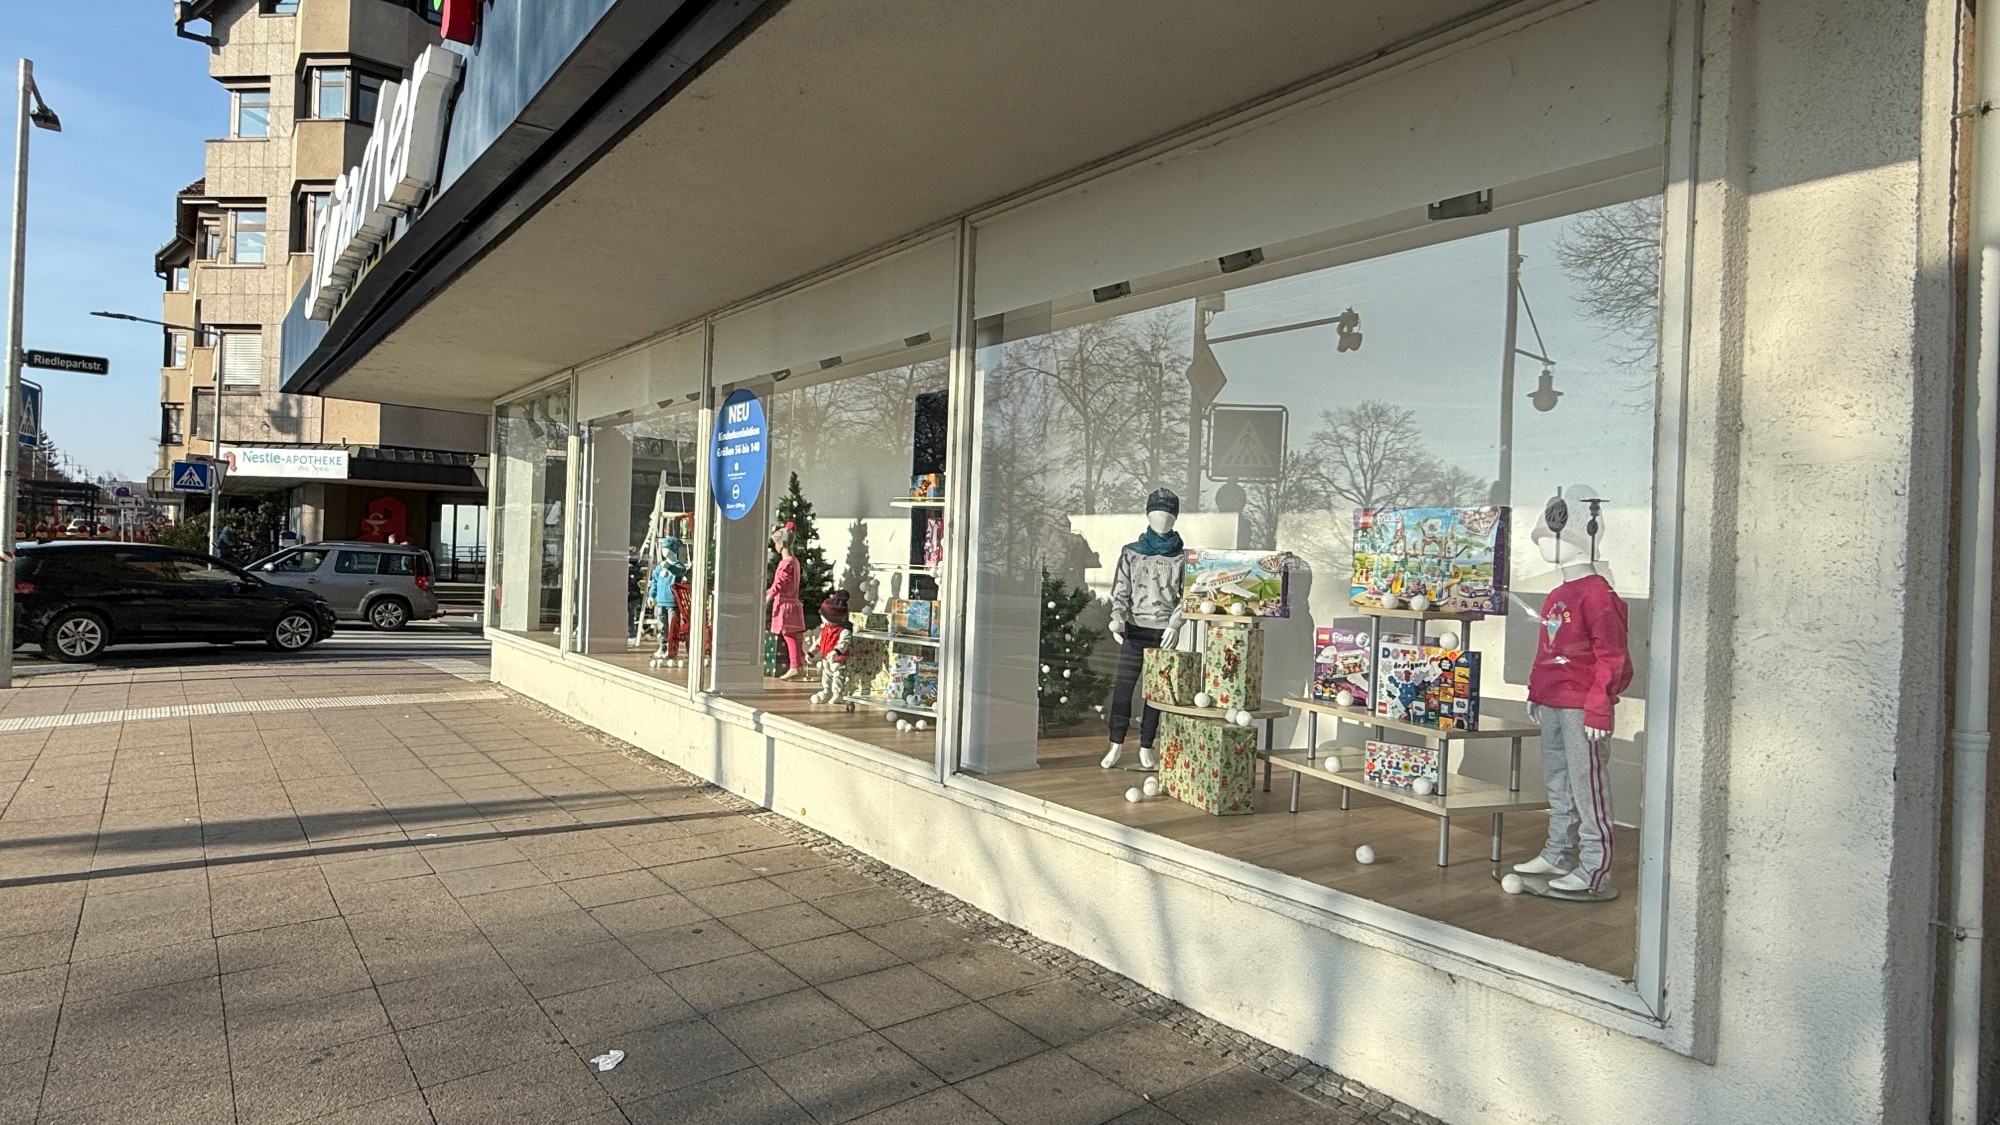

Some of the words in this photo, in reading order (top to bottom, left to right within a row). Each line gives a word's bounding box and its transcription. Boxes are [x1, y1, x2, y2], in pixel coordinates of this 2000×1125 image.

[33, 354, 104, 371] Riedleparkstr.
[728, 402, 750, 424] NEU
[1382, 647, 1417, 662] DOTS
[1393, 661, 1427, 670] designer
[1387, 760, 1420, 773] DOTS
